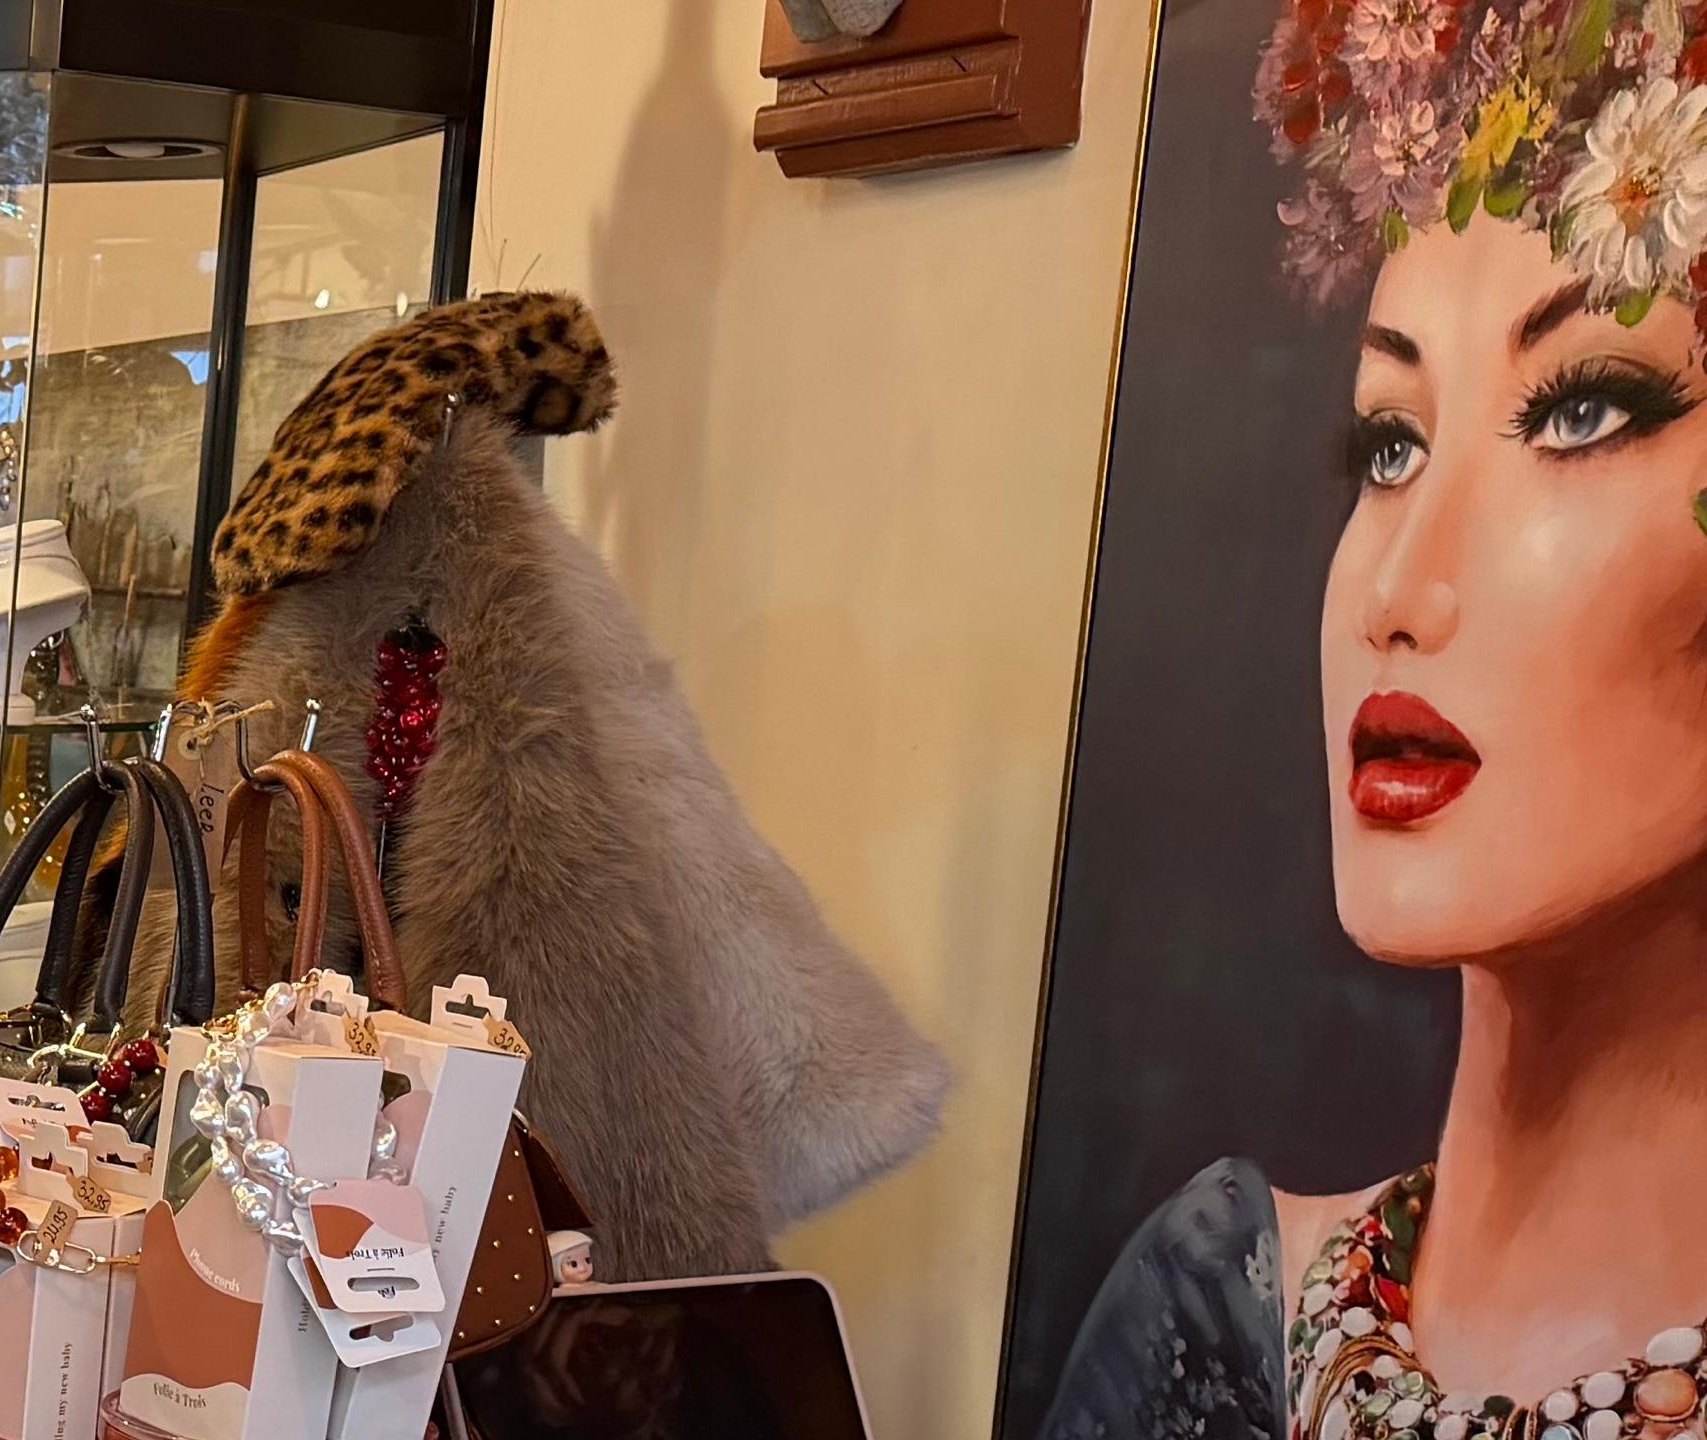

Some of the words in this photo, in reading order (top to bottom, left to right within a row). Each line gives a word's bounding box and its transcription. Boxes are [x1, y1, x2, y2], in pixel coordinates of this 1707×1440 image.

[76, 1180, 110, 1210] 32.95
[435, 1220, 447, 1243] new
[190, 1248, 214, 1279] Phone
[214, 1274, 240, 1293] cords
[61, 1342, 73, 1369] baby
[60, 1373, 69, 1395] new
[153, 1382, 175, 1400] Folie
[174, 1388, 180, 1404] à
[182, 1393, 207, 1409] Trois
[58, 1399, 68, 1416] my
